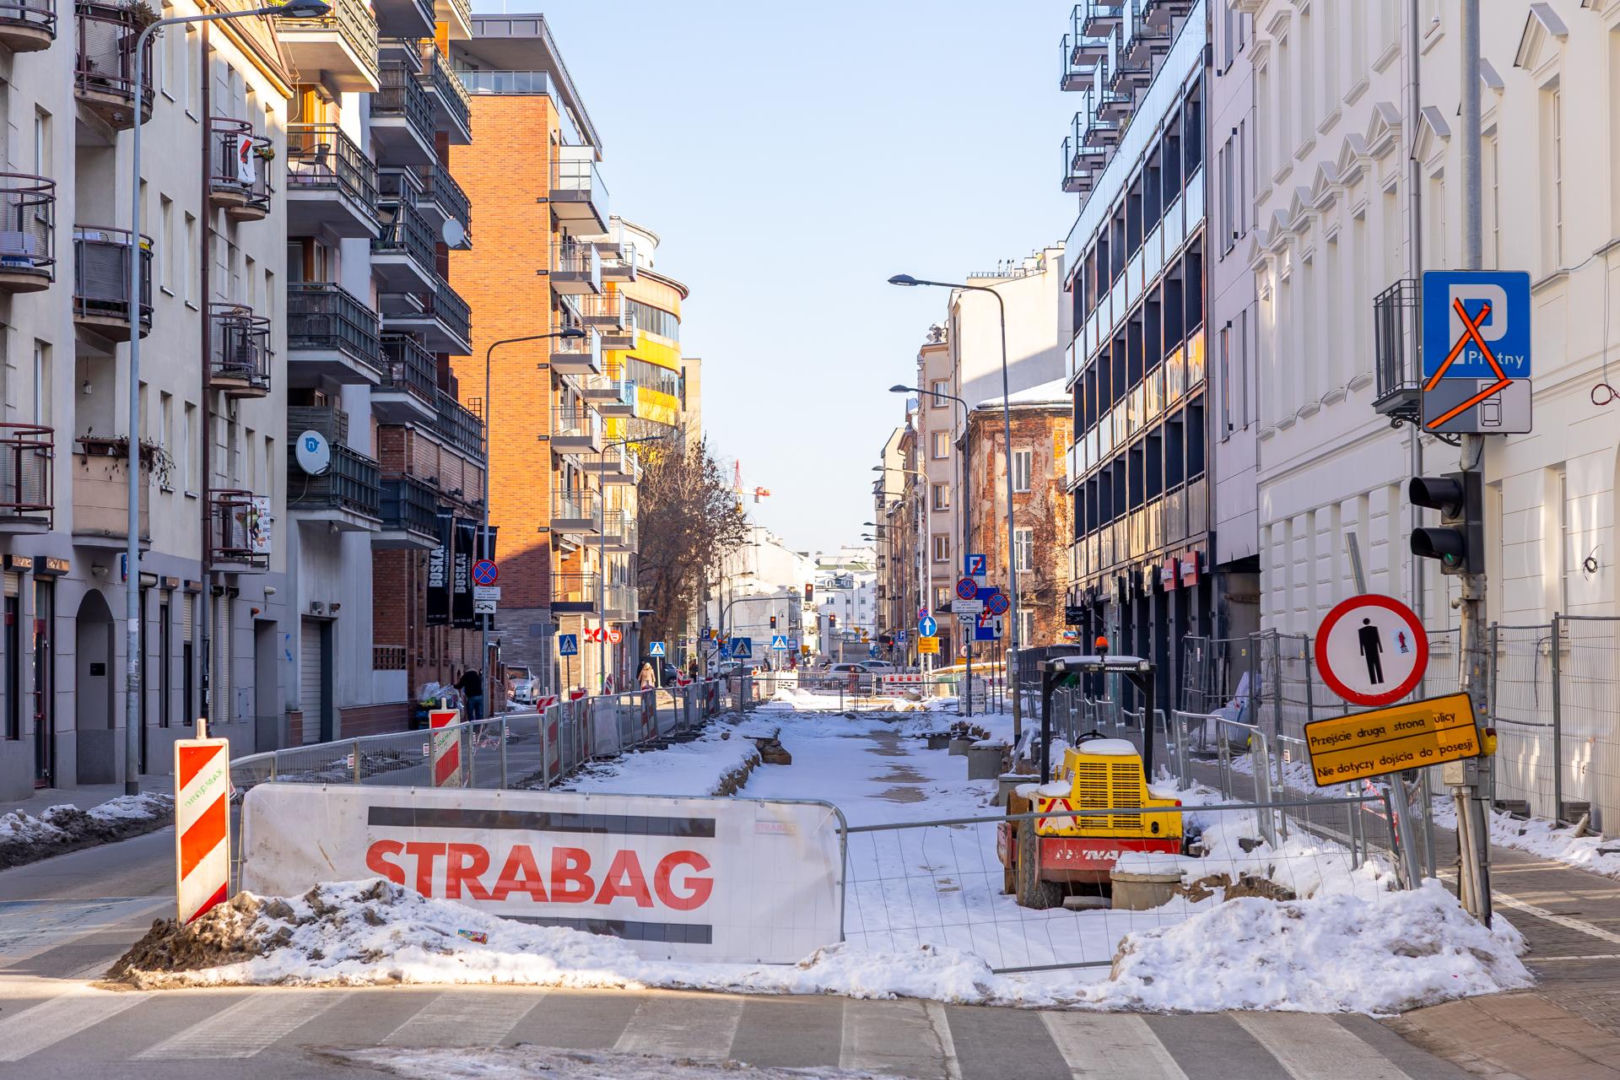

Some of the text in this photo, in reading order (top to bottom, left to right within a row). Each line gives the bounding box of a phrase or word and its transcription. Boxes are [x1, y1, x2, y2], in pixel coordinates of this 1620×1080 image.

[1449, 284, 1508, 364] P
[1469, 350, 1524, 369] Płtny
[1310, 712, 1456, 747] Przejście drugą stroną ulicy
[1317, 738, 1473, 778] Nie dotyczy dojścia do posesji
[365, 839, 714, 911] STRABAG
